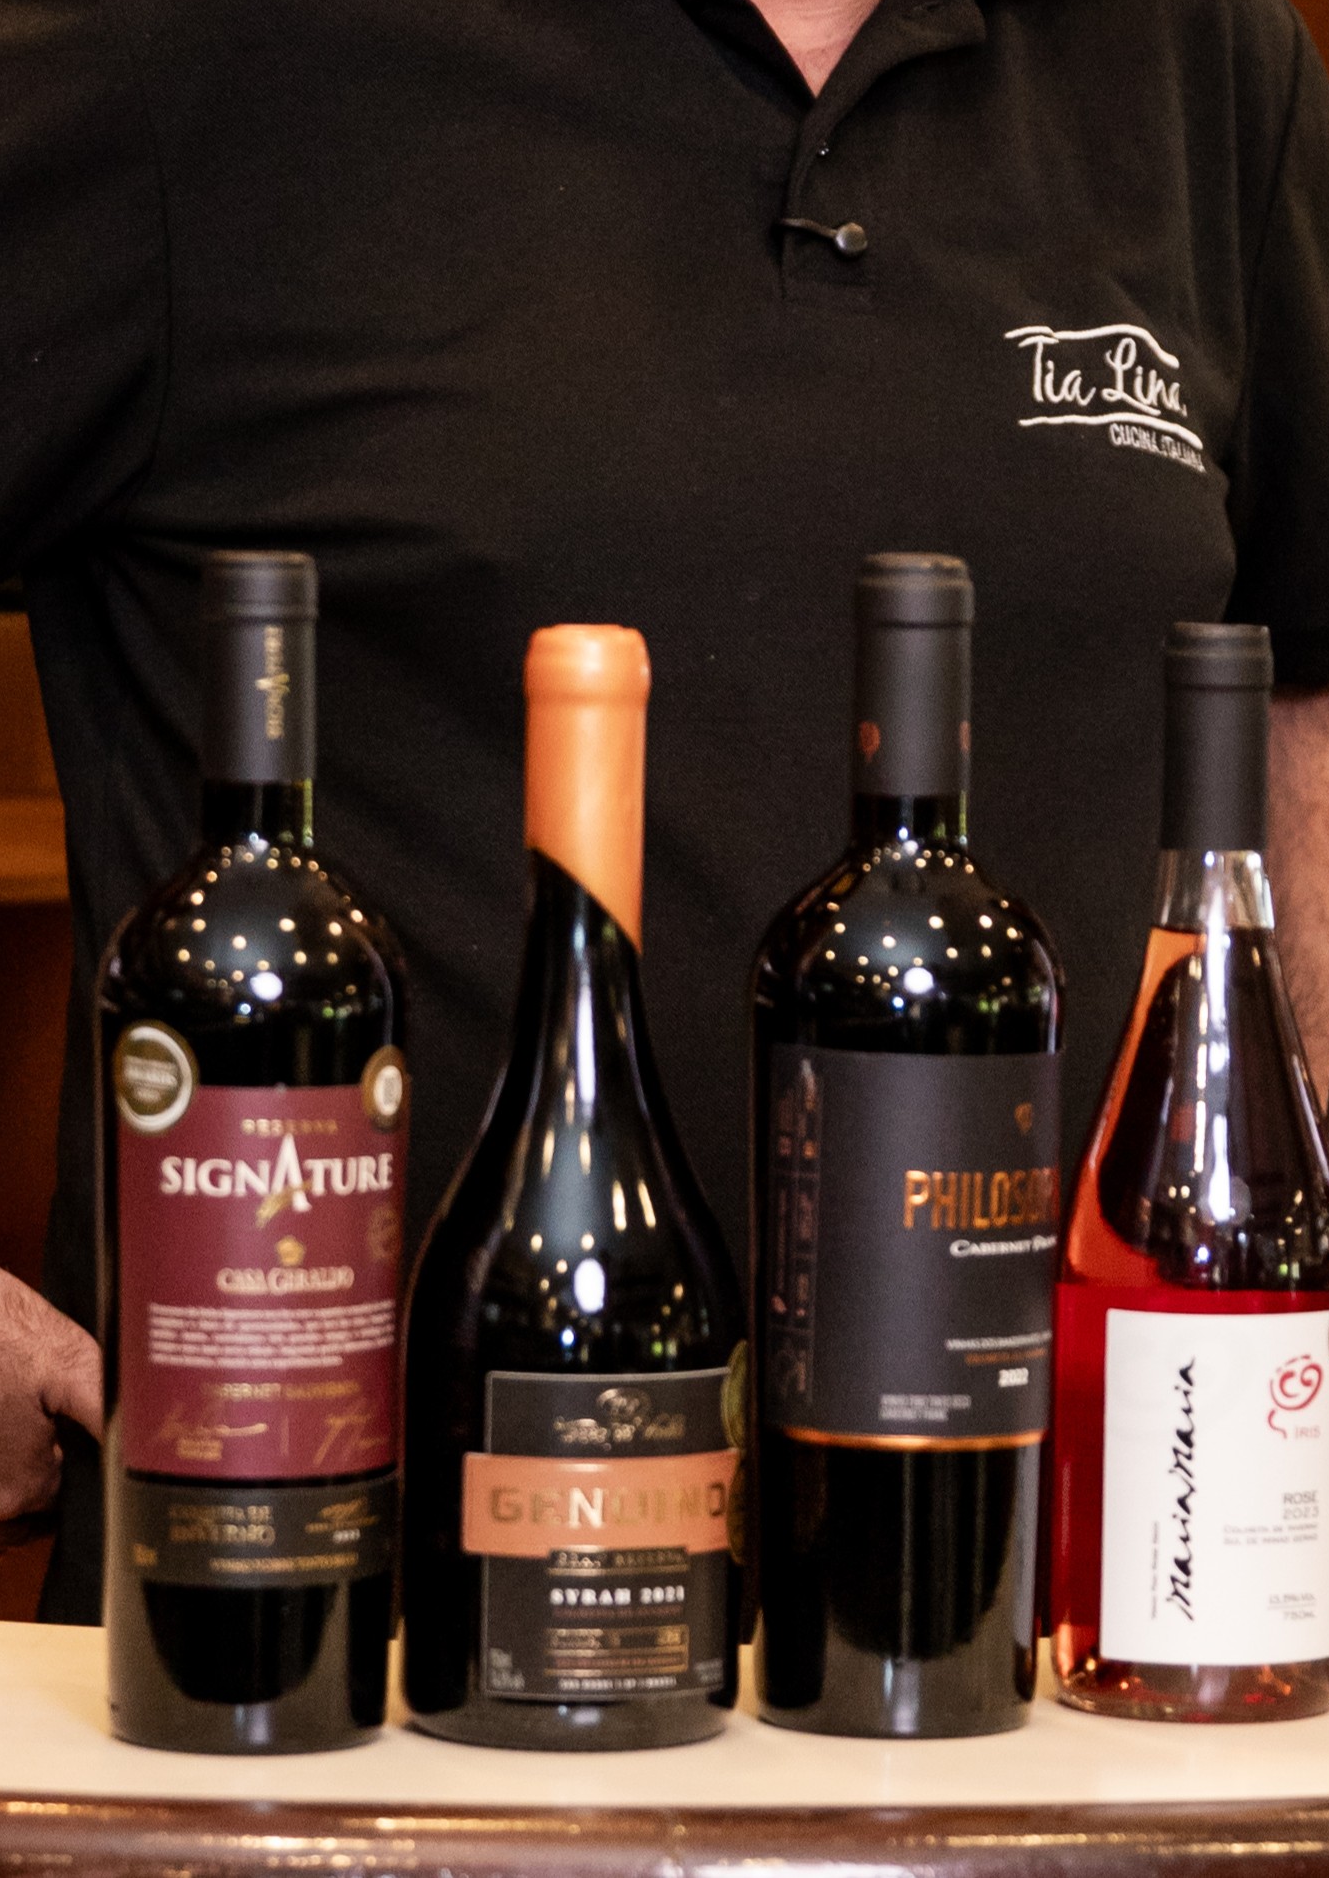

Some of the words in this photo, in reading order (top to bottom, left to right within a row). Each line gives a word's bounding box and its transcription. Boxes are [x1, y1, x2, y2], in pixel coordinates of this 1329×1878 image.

[1018, 335, 1096, 406] Tia
[1102, 337, 1187, 417] Lina
[1109, 422, 1160, 454] CUCINA
[160, 1133, 394, 1212] SIGNATURE
[550, 1588, 631, 1606] SYRAH
